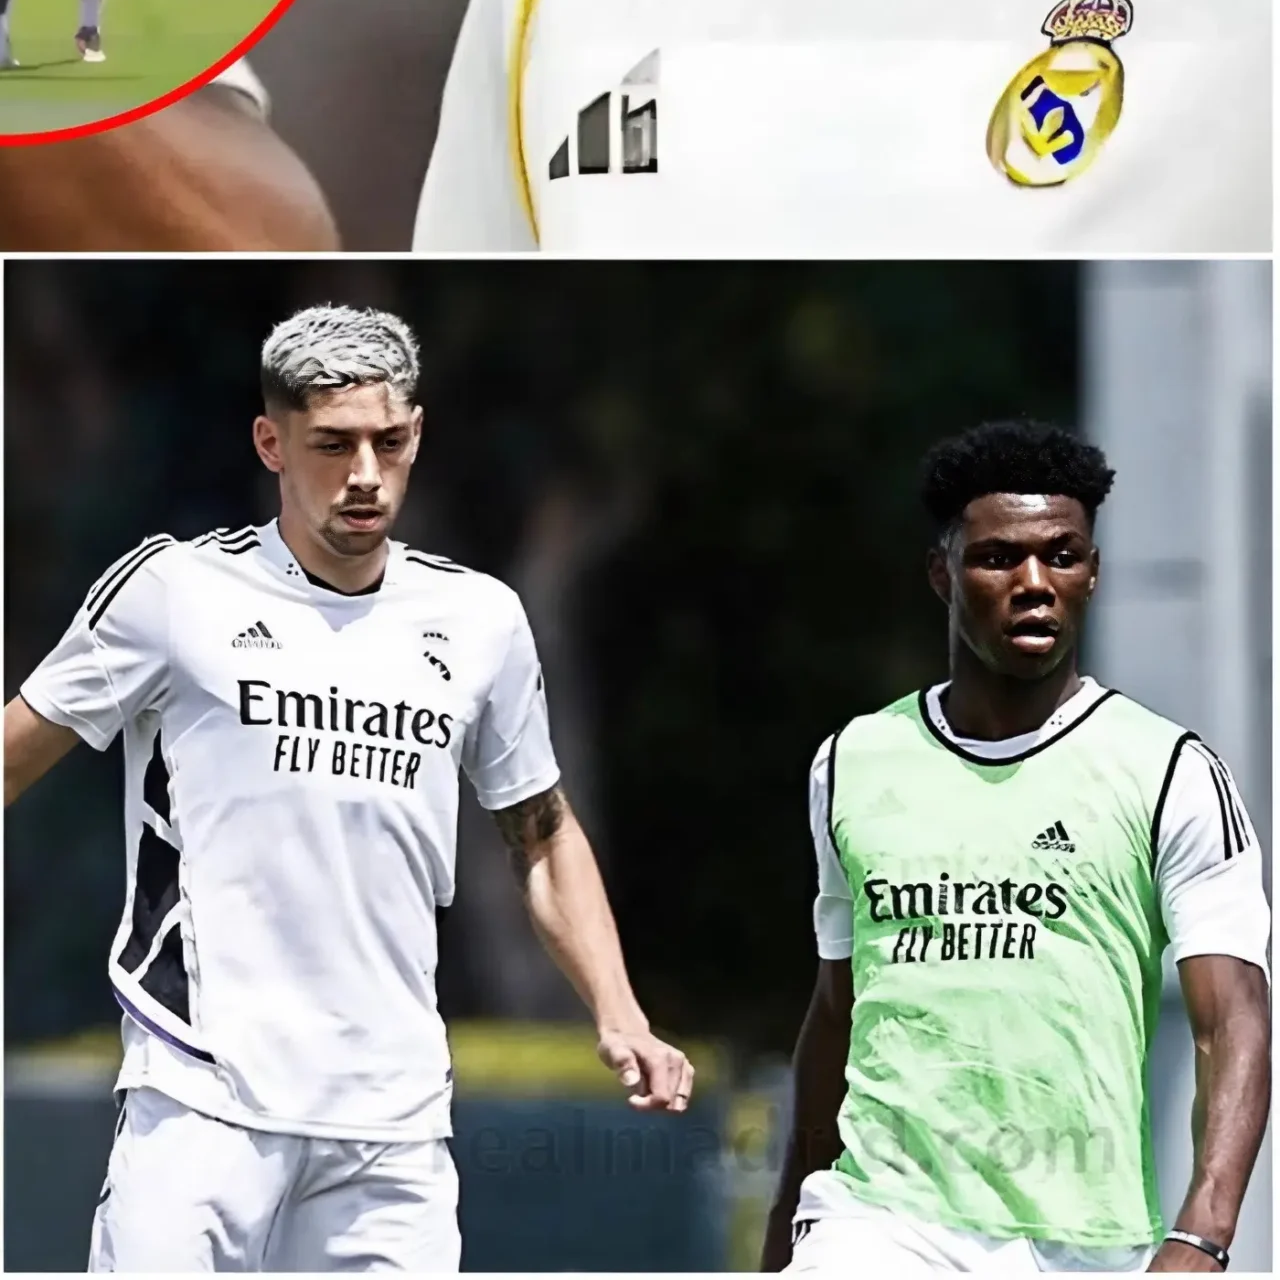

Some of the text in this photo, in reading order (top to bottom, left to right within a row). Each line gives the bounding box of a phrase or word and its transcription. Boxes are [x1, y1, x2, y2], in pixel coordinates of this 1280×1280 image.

[237, 680, 454, 749] Emirates
[274, 735, 421, 790] FLY BETTER
[864, 872, 1067, 922] Emirates
[892, 923, 1037, 963] FLY BETTER
